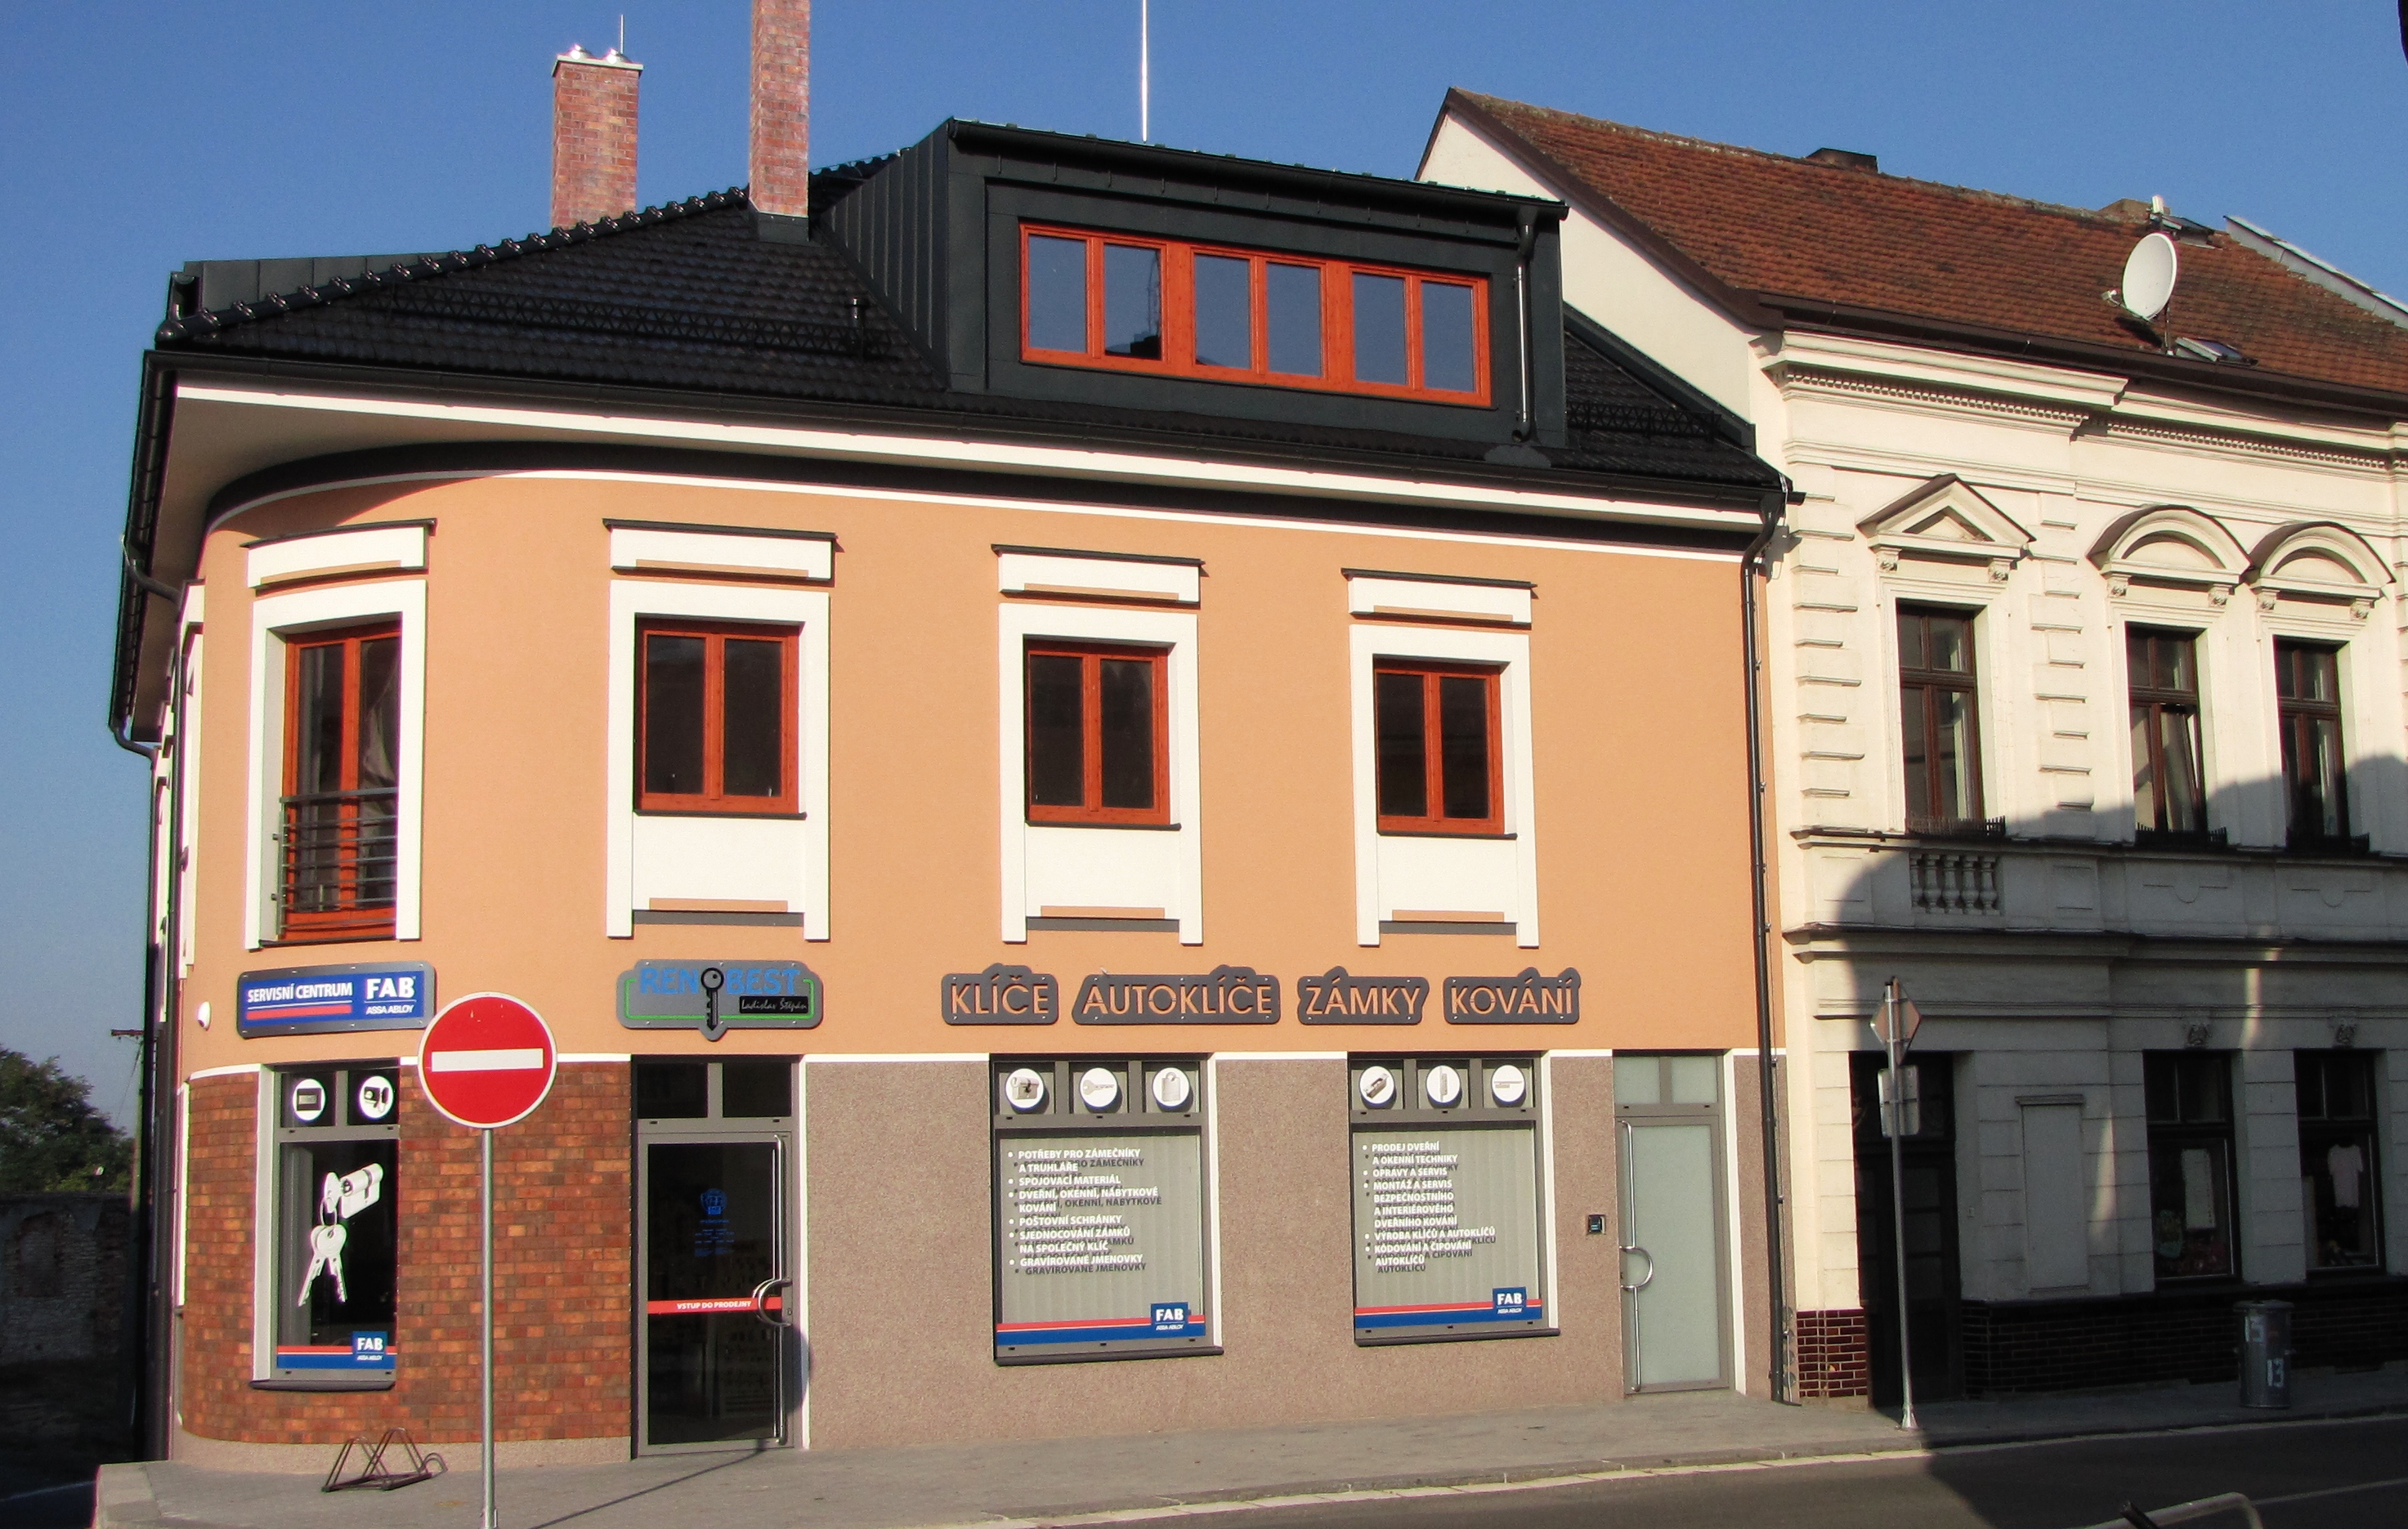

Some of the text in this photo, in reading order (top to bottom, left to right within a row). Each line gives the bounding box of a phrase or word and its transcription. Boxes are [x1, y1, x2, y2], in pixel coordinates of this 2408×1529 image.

[248, 982, 352, 1003] SERVISNÍ CENTRUM
[366, 977, 415, 999] FAB
[951, 973, 1049, 1015] KLÍČE
[1082, 975, 1272, 1015] AUTOKLÍČE
[1305, 977, 1421, 1015] ZÁMKY
[1451, 977, 1573, 1014] KOVÁNÍ
[366, 1004, 414, 1015] ASSA ABLOY
[1372, 1141, 1439, 1152] PRODEJ DVEŘNÍ
[1018, 1147, 1141, 1159] POTŘEBY PRO ZÁMEČNÍKY
[1372, 1154, 1458, 1165] A OKENNÍ TECHNIKY
[1018, 1162, 1079, 1173] A TRUHLÁŘE
[1372, 1167, 1448, 1178] OPRAVY A SERVIS
[1018, 1174, 1121, 1186] SPOJOVACÍ MATERIÁL
[1373, 1179, 1452, 1190] MONTÁŽ A SERVIS
[1101, 1186, 1158, 1197] NÁBYTKOVÉ
[1374, 1191, 1454, 1203] BEZPEČNOSTNÍHO
[1019, 1201, 1057, 1213] KOVÁNÍ
[1374, 1205, 1454, 1215] A INTERIÉROVÉHO
[1019, 1214, 1122, 1226] POŠTOVNÍ SCHRÁNKY
[1423, 1215, 1457, 1227] KOVÁNÍ
[1019, 1226, 1130, 1240] SJEDNOCOVÁNÍ ZÁMKŮ
[1374, 1226, 1496, 1241] VÝROBA KLÍČŮ A AUTOKLÍČŮ
[1020, 1241, 1109, 1253] NA SPOLEČNÝ KLÍČ
[1374, 1241, 1472, 1254] KÓDOVÁNÍ A ČIPOVÁNÍ
[1090, 1254, 1144, 1265] JMENOVKY
[1375, 1254, 1425, 1266] AUTOKLÍČŮ
[1497, 1293, 1522, 1305] FAB
[1156, 1308, 1184, 1321] FAB
[357, 1337, 383, 1351] FAB
